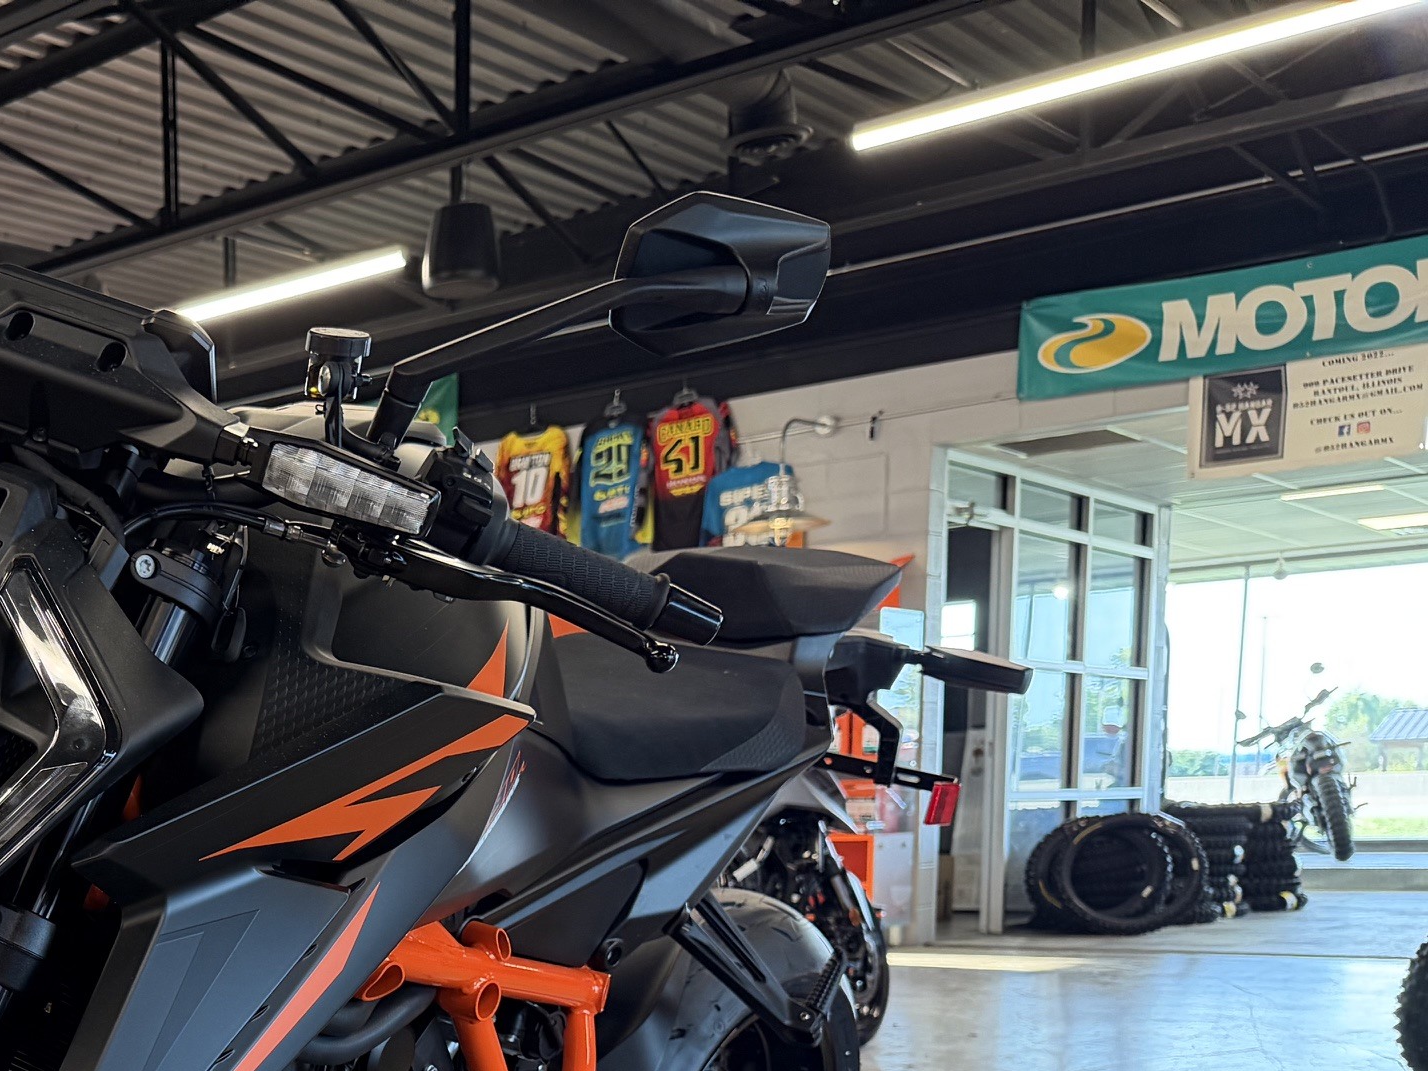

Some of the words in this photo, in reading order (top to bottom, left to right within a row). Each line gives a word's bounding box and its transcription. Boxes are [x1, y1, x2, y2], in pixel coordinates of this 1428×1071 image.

[1158, 258, 1428, 362] MOTO
[1322, 355, 1358, 367] COMING
[1322, 370, 1383, 386] PACESETTER
[1385, 365, 1415, 376] DRIVE
[1362, 377, 1403, 389] ILLINOIS
[1214, 408, 1272, 448] MX
[1310, 413, 1344, 426] CHECK
[1345, 412, 1357, 422] US
[1358, 410, 1377, 421] OUT
[662, 434, 704, 477] 41
[510, 466, 550, 509] 10
